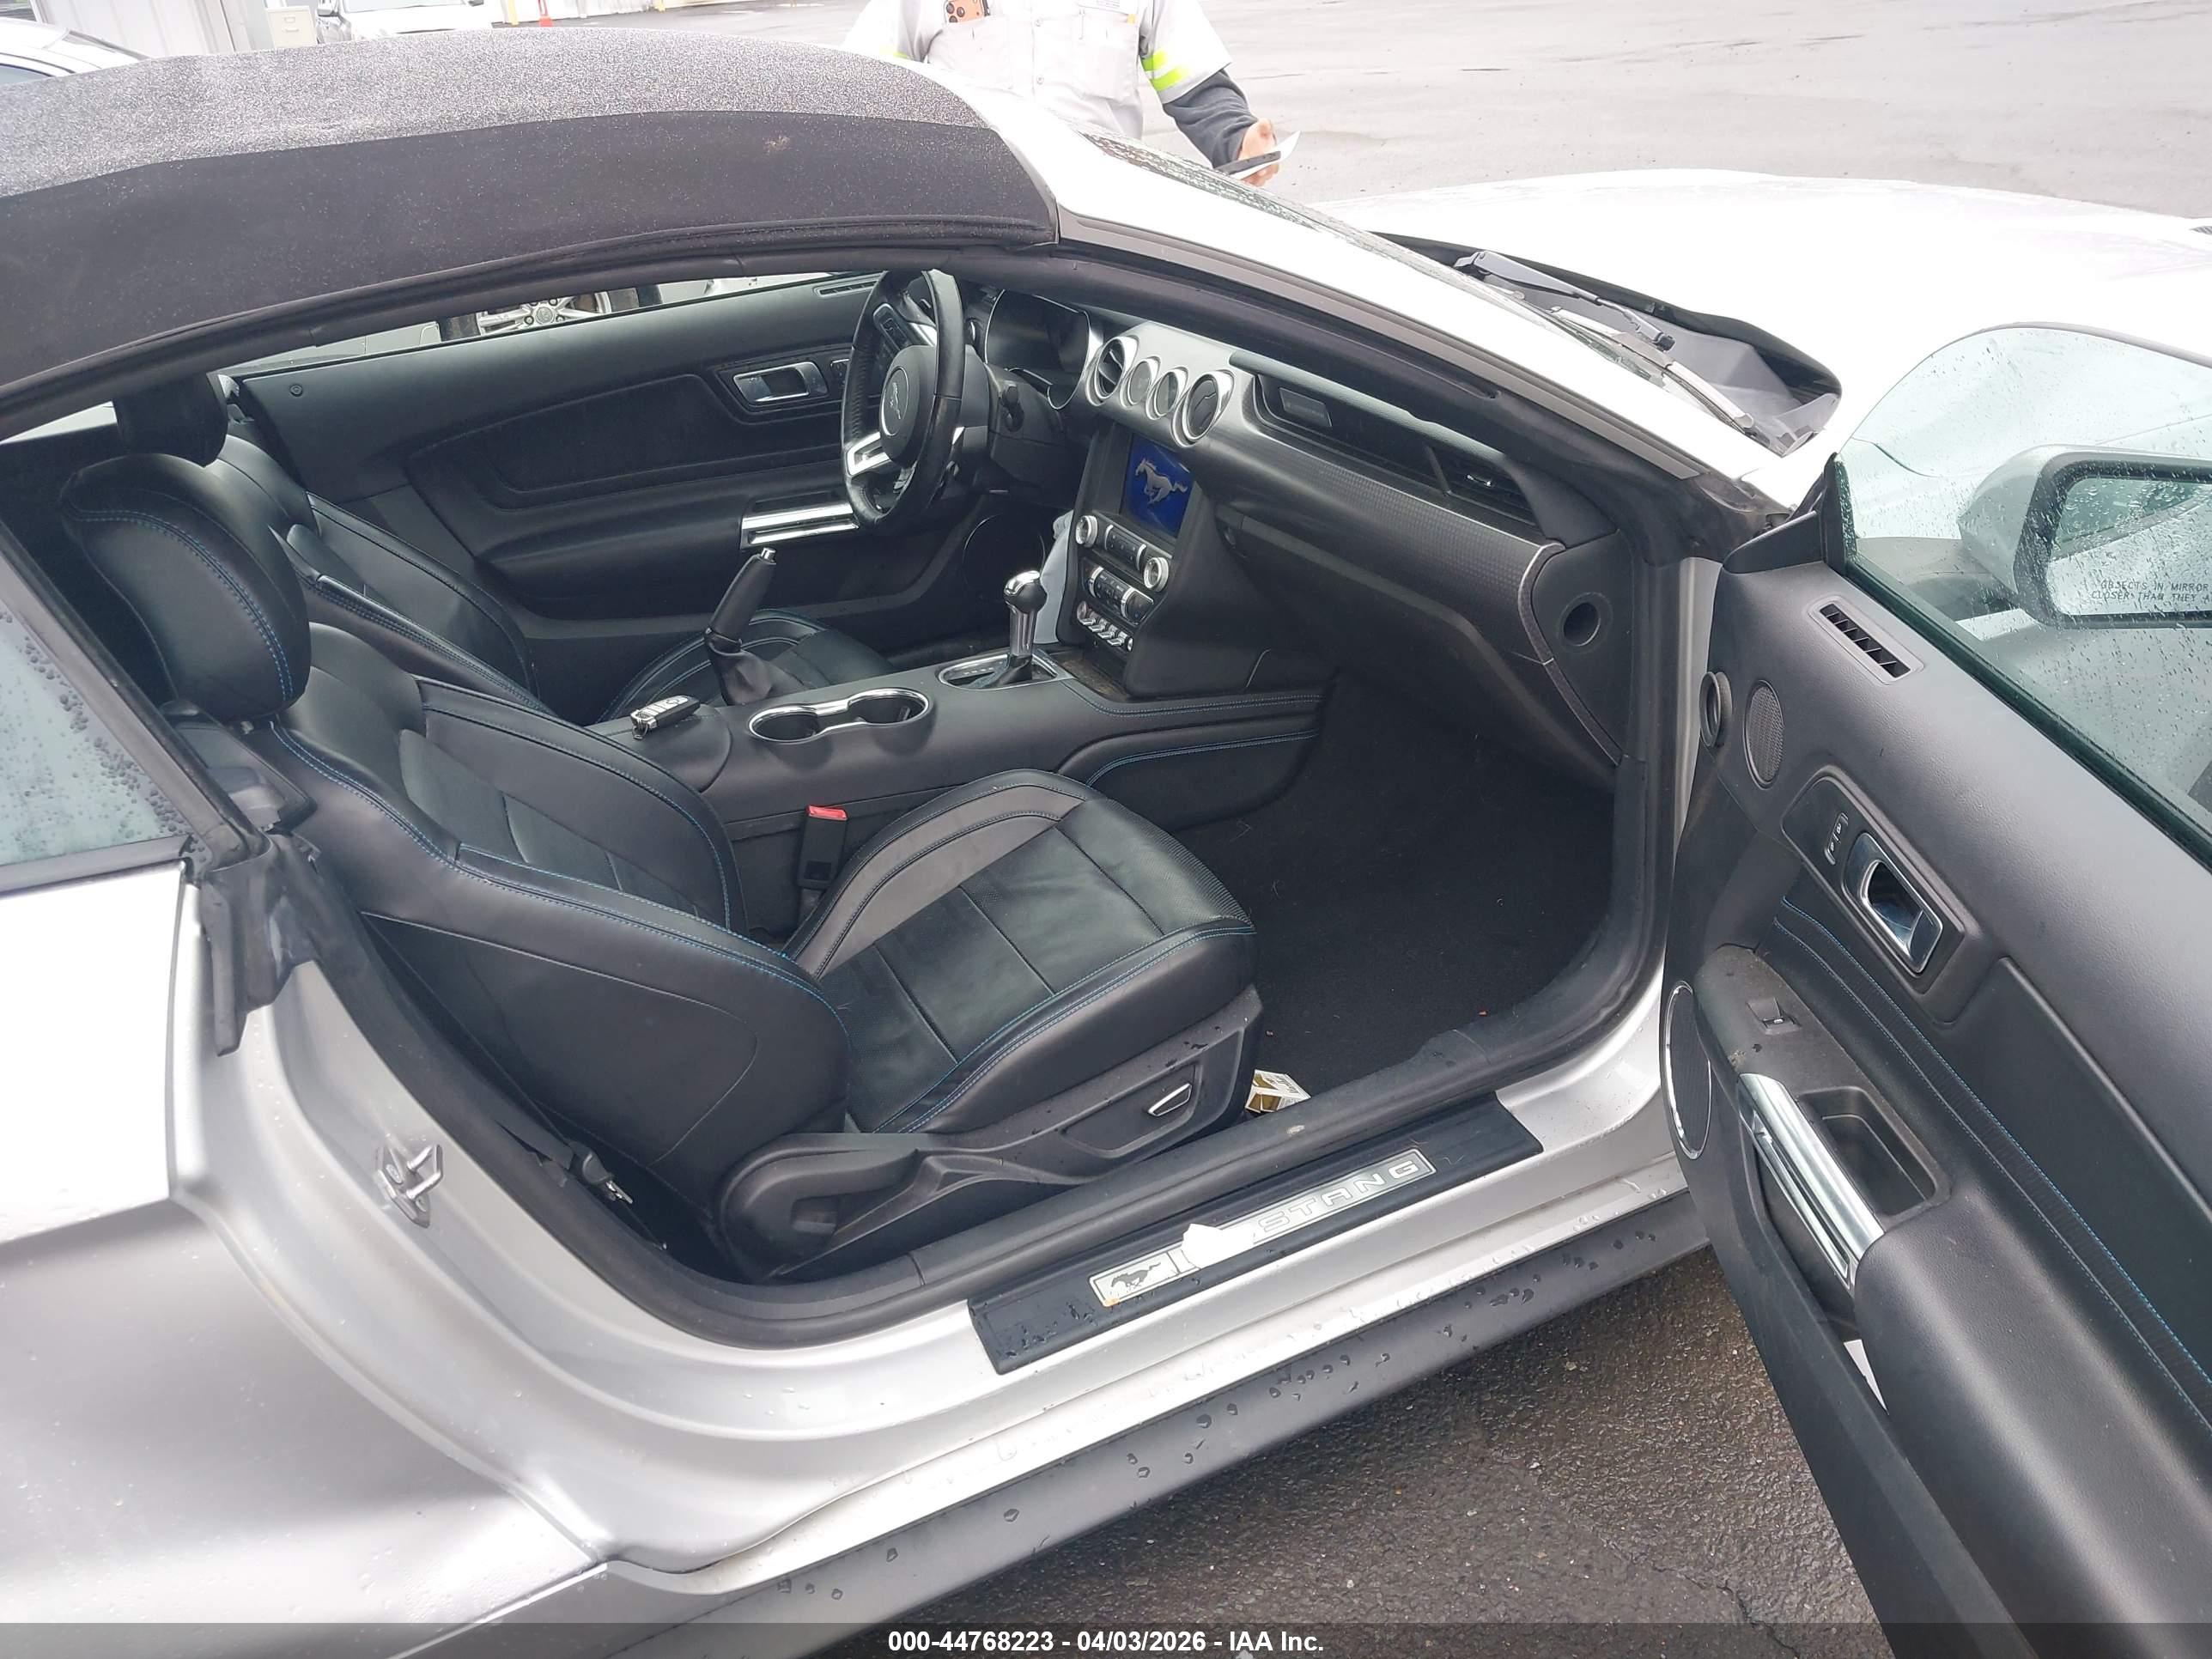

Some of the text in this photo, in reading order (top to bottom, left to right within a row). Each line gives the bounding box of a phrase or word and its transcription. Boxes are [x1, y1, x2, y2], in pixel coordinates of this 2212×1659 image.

[2154, 581, 2164, 591] IN
[2171, 583, 2209, 592] MIRROR
[2092, 591, 2130, 600] CLOSER
[2138, 592, 2165, 600] THAN
[2172, 592, 2197, 602] THEY
[1258, 1160, 1419, 1233] STANG
